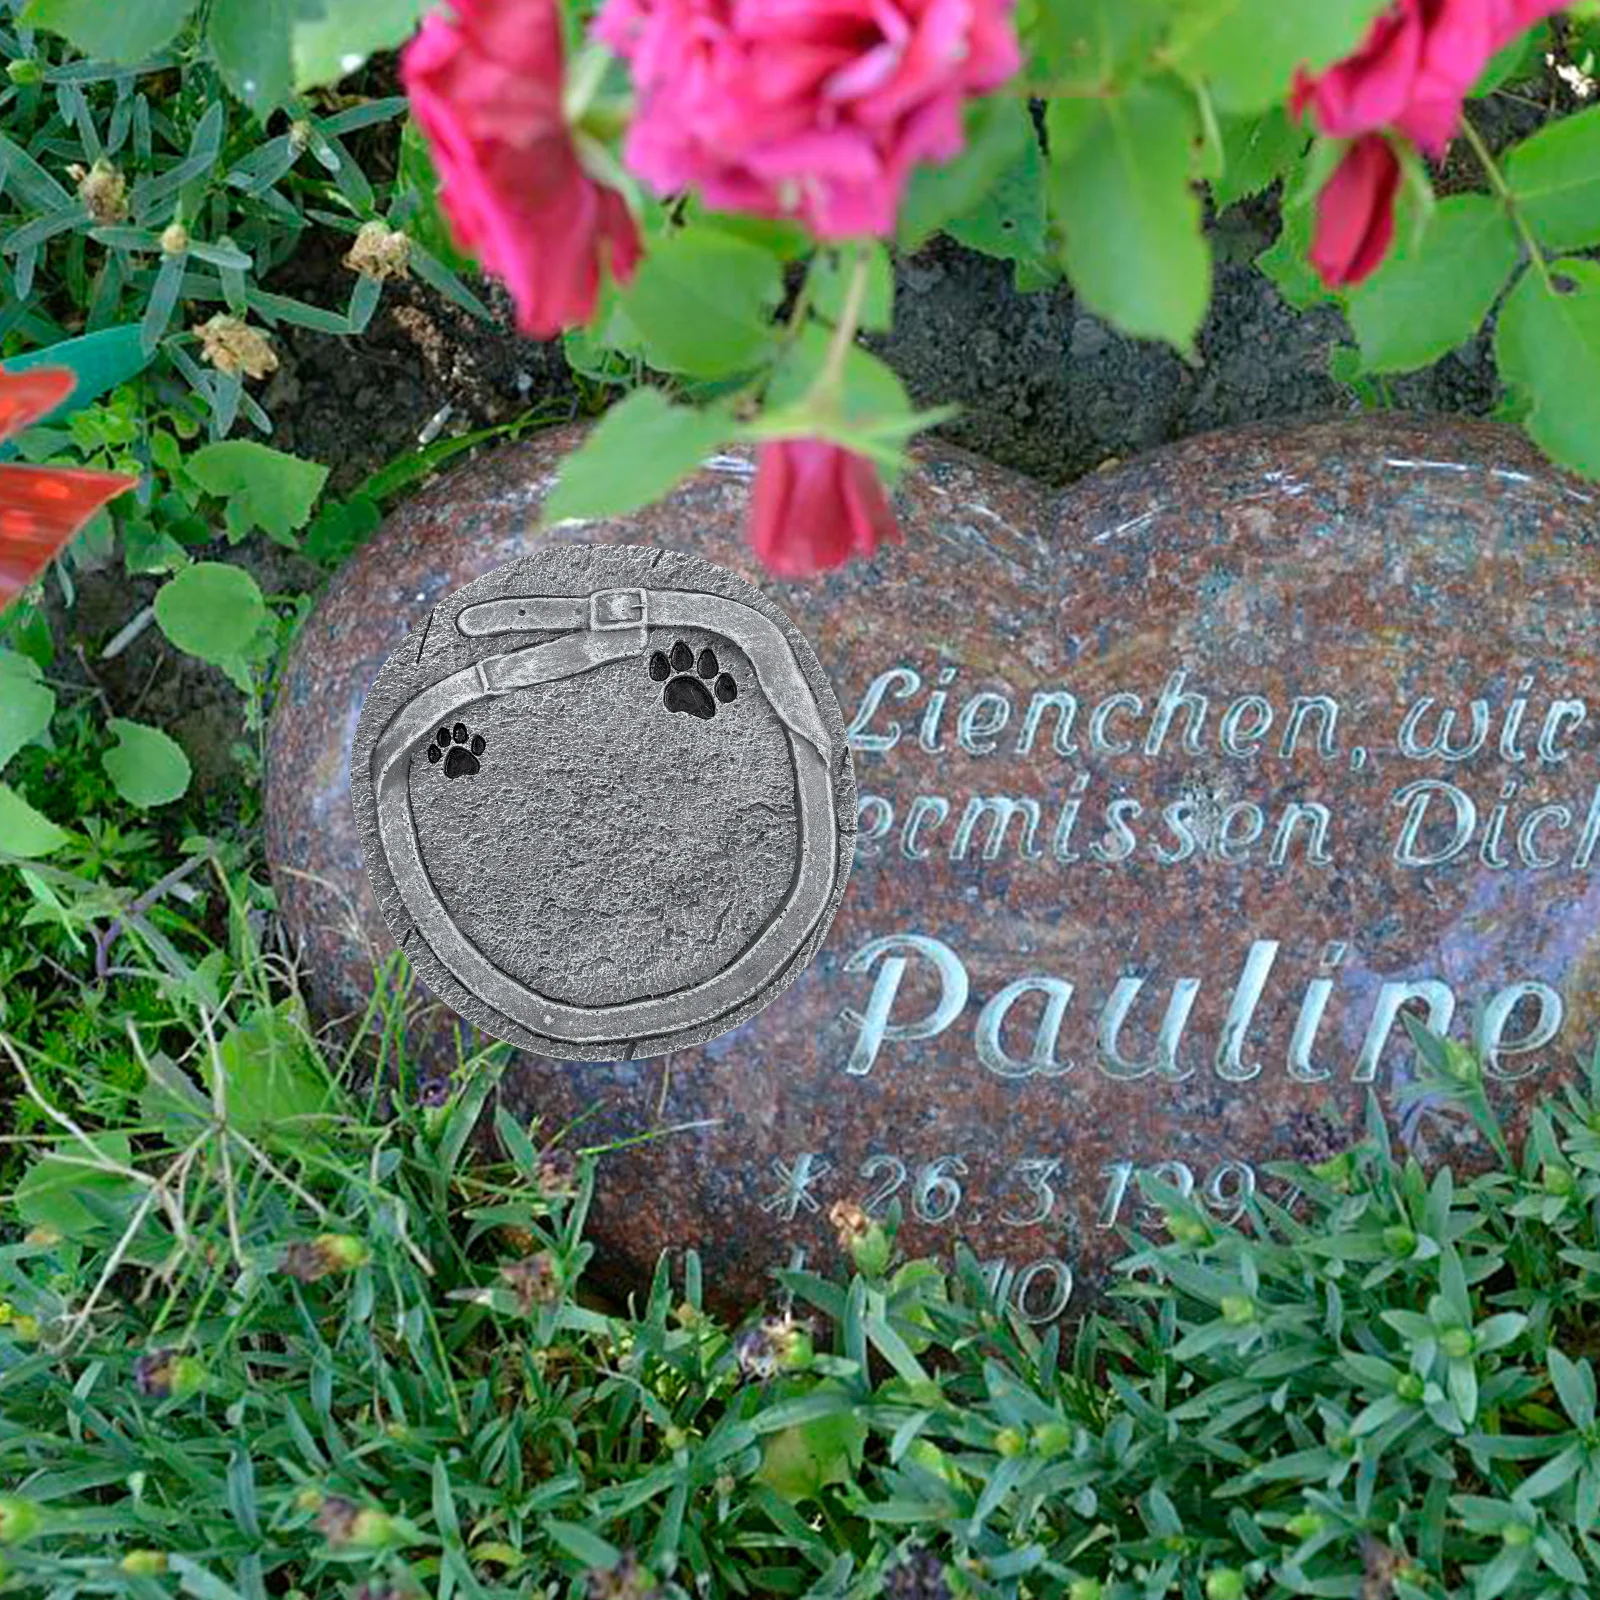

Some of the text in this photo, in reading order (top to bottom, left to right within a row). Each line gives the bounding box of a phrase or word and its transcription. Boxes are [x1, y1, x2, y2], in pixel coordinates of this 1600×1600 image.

[847, 667, 1587, 771] Lienchen, wir
[856, 772, 1333, 868] ermissen
[838, 933, 1566, 1084] Pauline
